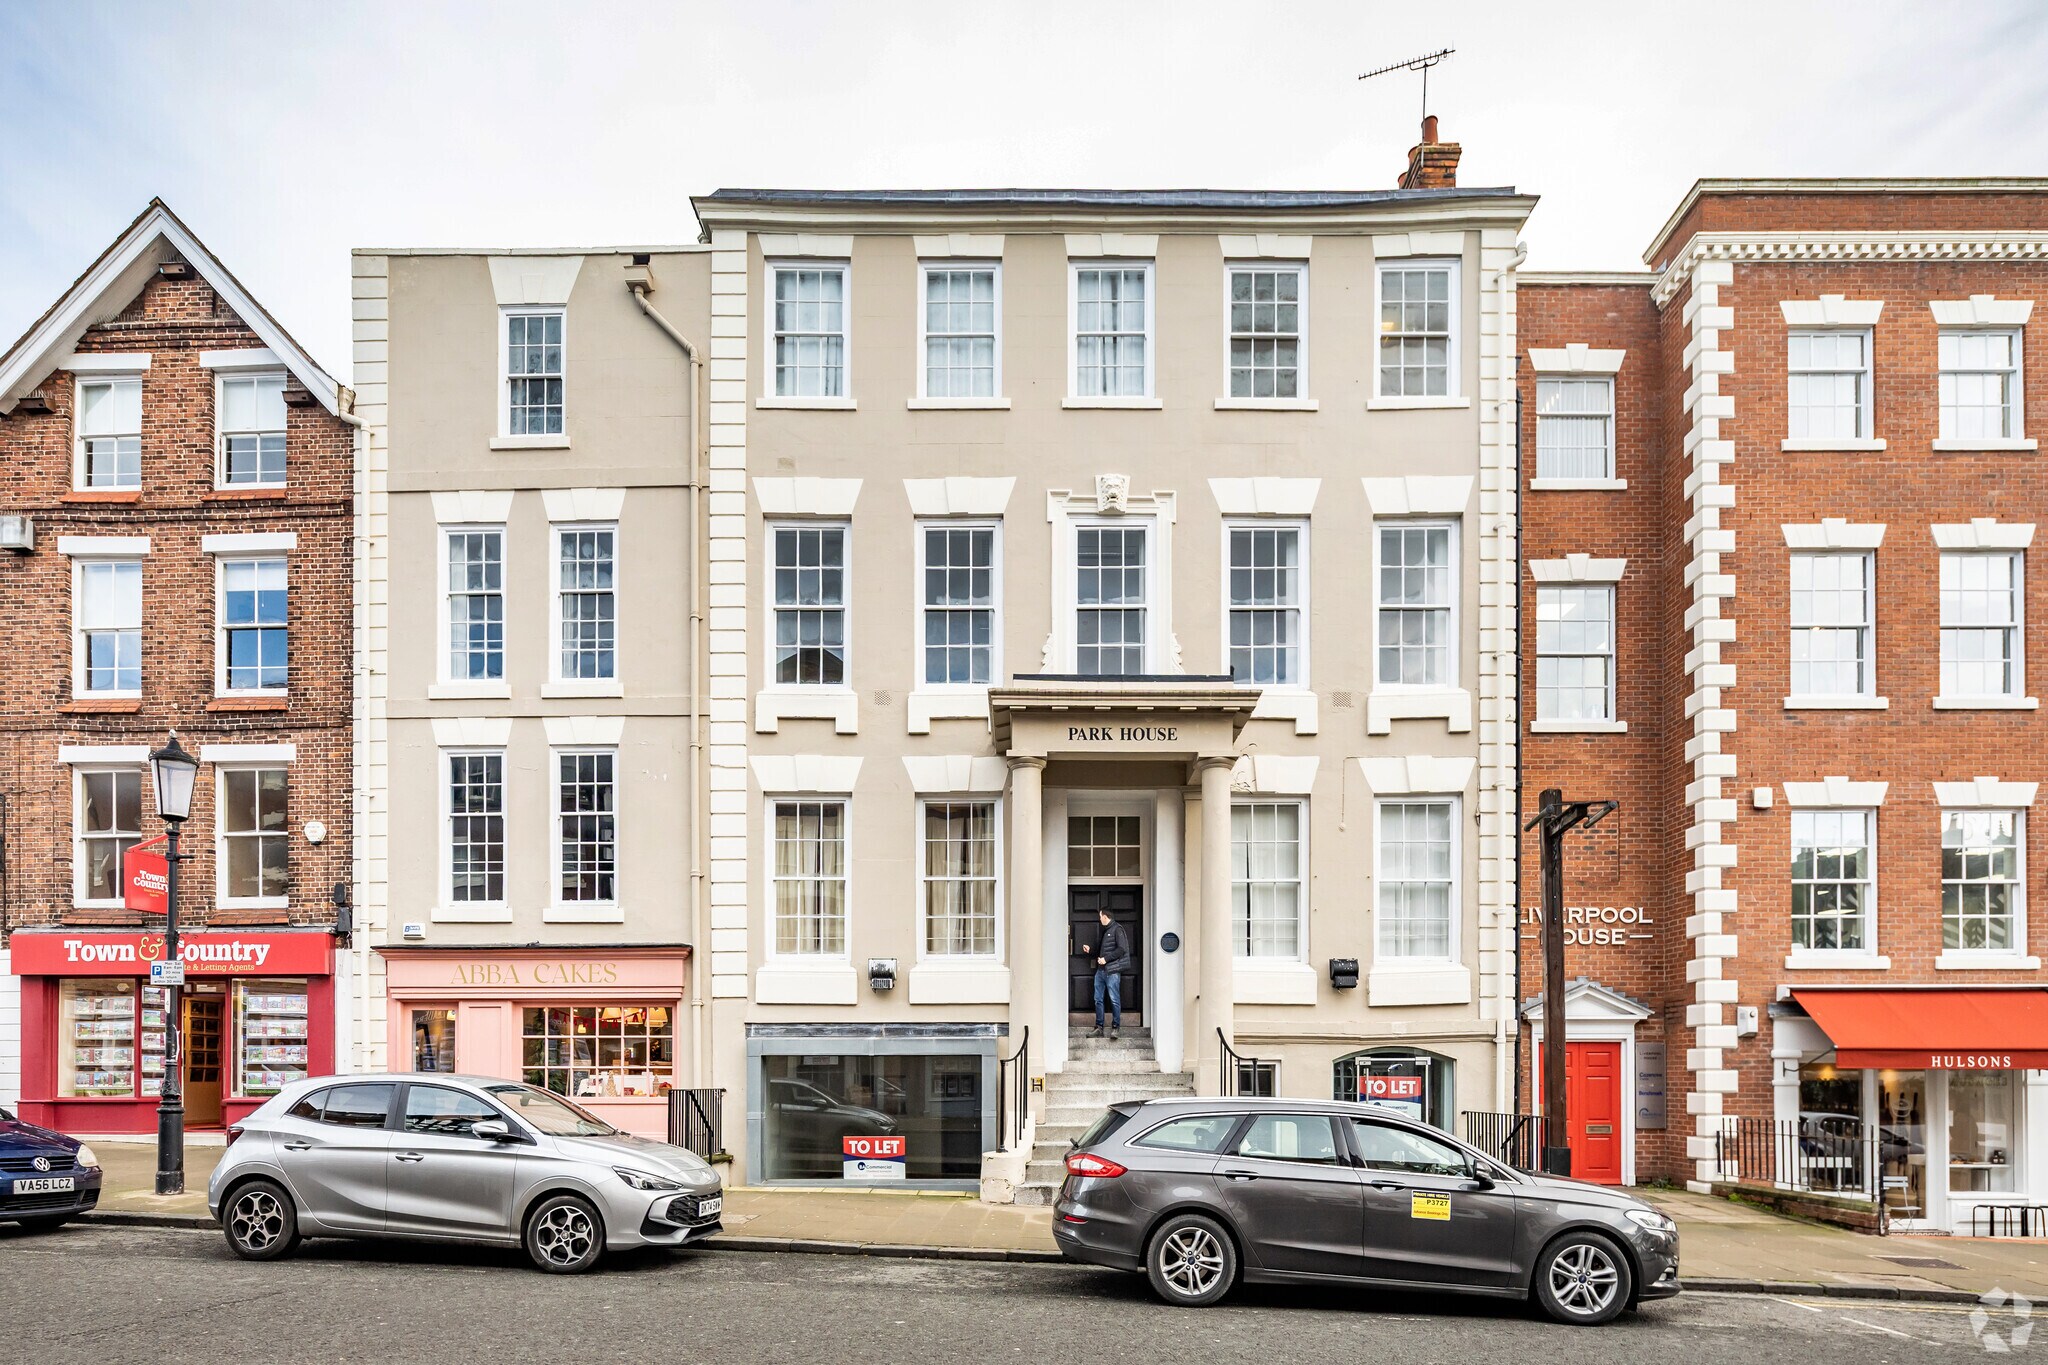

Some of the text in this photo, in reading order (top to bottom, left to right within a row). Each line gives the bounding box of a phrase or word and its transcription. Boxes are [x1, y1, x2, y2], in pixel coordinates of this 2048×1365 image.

[1068, 727, 1178, 741] PARK HOUSE
[139, 870, 166, 883] Town
[133, 876, 169, 893] Country
[1520, 907, 1654, 924] IVRPOOL
[1541, 928, 1626, 945] OUSE
[63, 940, 136, 962] Town
[138, 936, 164, 961] &
[200, 964, 227, 972] Letting
[228, 964, 255, 972] Agents
[451, 963, 617, 984] ABBA CAKES
[1931, 1056, 2012, 1068] HULSONS
[1364, 1080, 1417, 1095] TO LET
[848, 1140, 900, 1155] TO LET
[20, 1178, 71, 1191] VA56 LCZ
